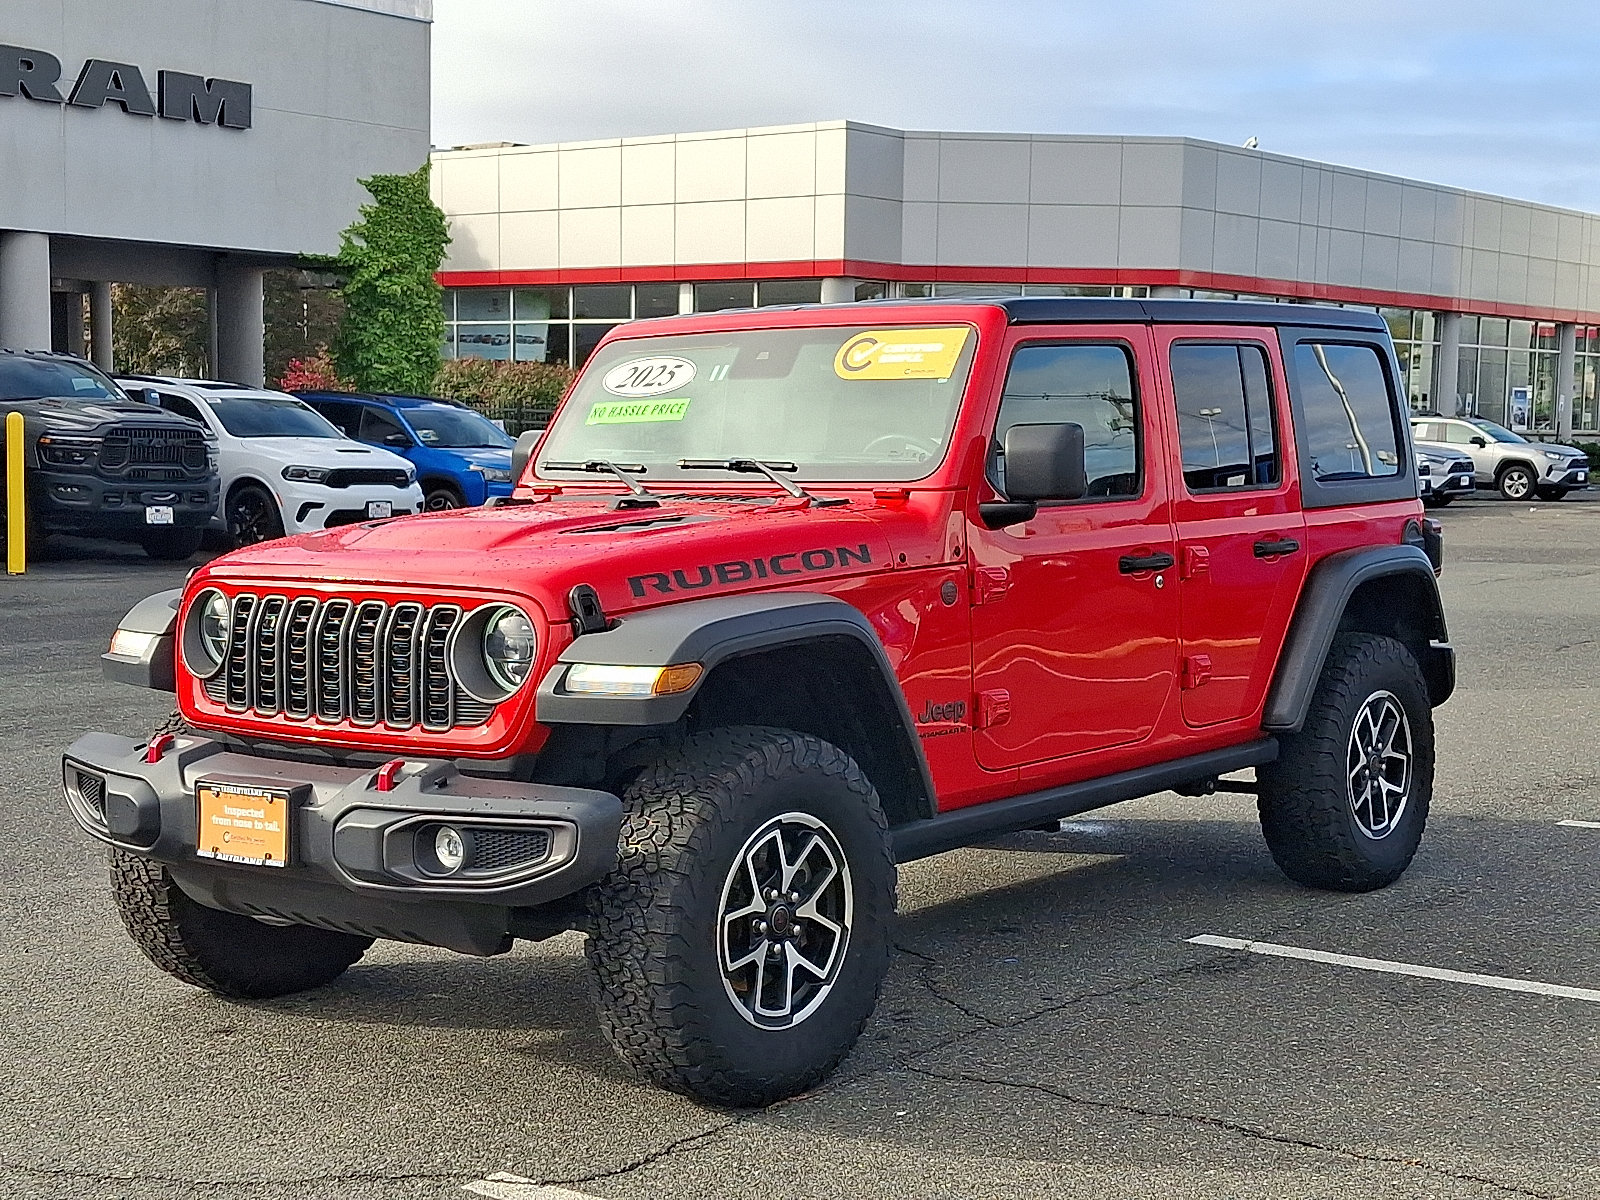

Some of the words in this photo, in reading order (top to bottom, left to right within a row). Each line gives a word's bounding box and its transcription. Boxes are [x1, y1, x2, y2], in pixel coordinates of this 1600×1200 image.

[0, 43, 252, 129] RAM
[615, 365, 684, 388] 2025
[590, 407, 606, 418] NO
[608, 404, 651, 417] HASSLE
[651, 403, 685, 415] PRICE
[626, 543, 872, 598] RUBICON
[918, 699, 966, 724] Jeep
[212, 815, 232, 826] from
[254, 819, 264, 830] to
[225, 805, 264, 818] Inspected
